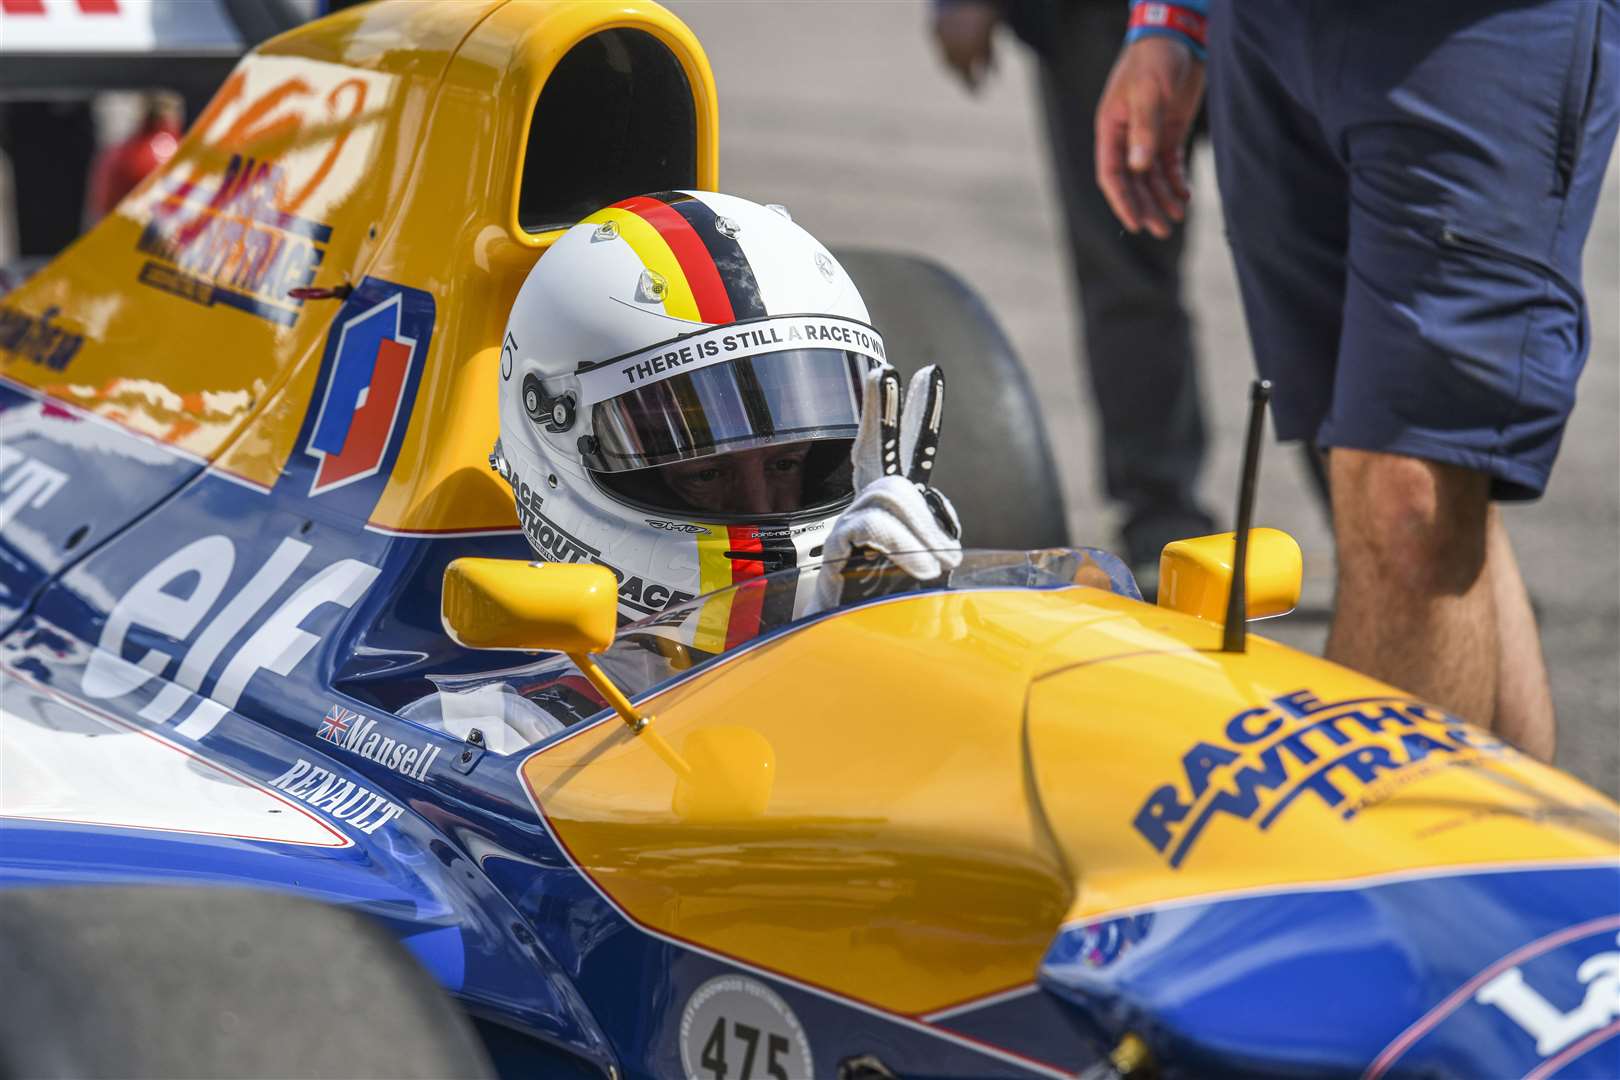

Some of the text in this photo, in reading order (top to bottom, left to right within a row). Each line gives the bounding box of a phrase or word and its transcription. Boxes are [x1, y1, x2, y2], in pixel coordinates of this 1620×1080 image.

[622, 347, 694, 383] THERE
[697, 340, 719, 359] IS
[724, 328, 783, 353] STILL
[788, 326, 803, 341] A
[805, 325, 851, 343] RACE
[853, 330, 870, 349] TO
[518, 504, 589, 563] THOUT
[591, 555, 695, 610] ACE
[82, 535, 382, 741] elf
[341, 714, 441, 782] Mansell
[1132, 690, 1318, 854] RACE
[268, 758, 405, 835] RENAULT
[701, 1015, 790, 1080] 475
